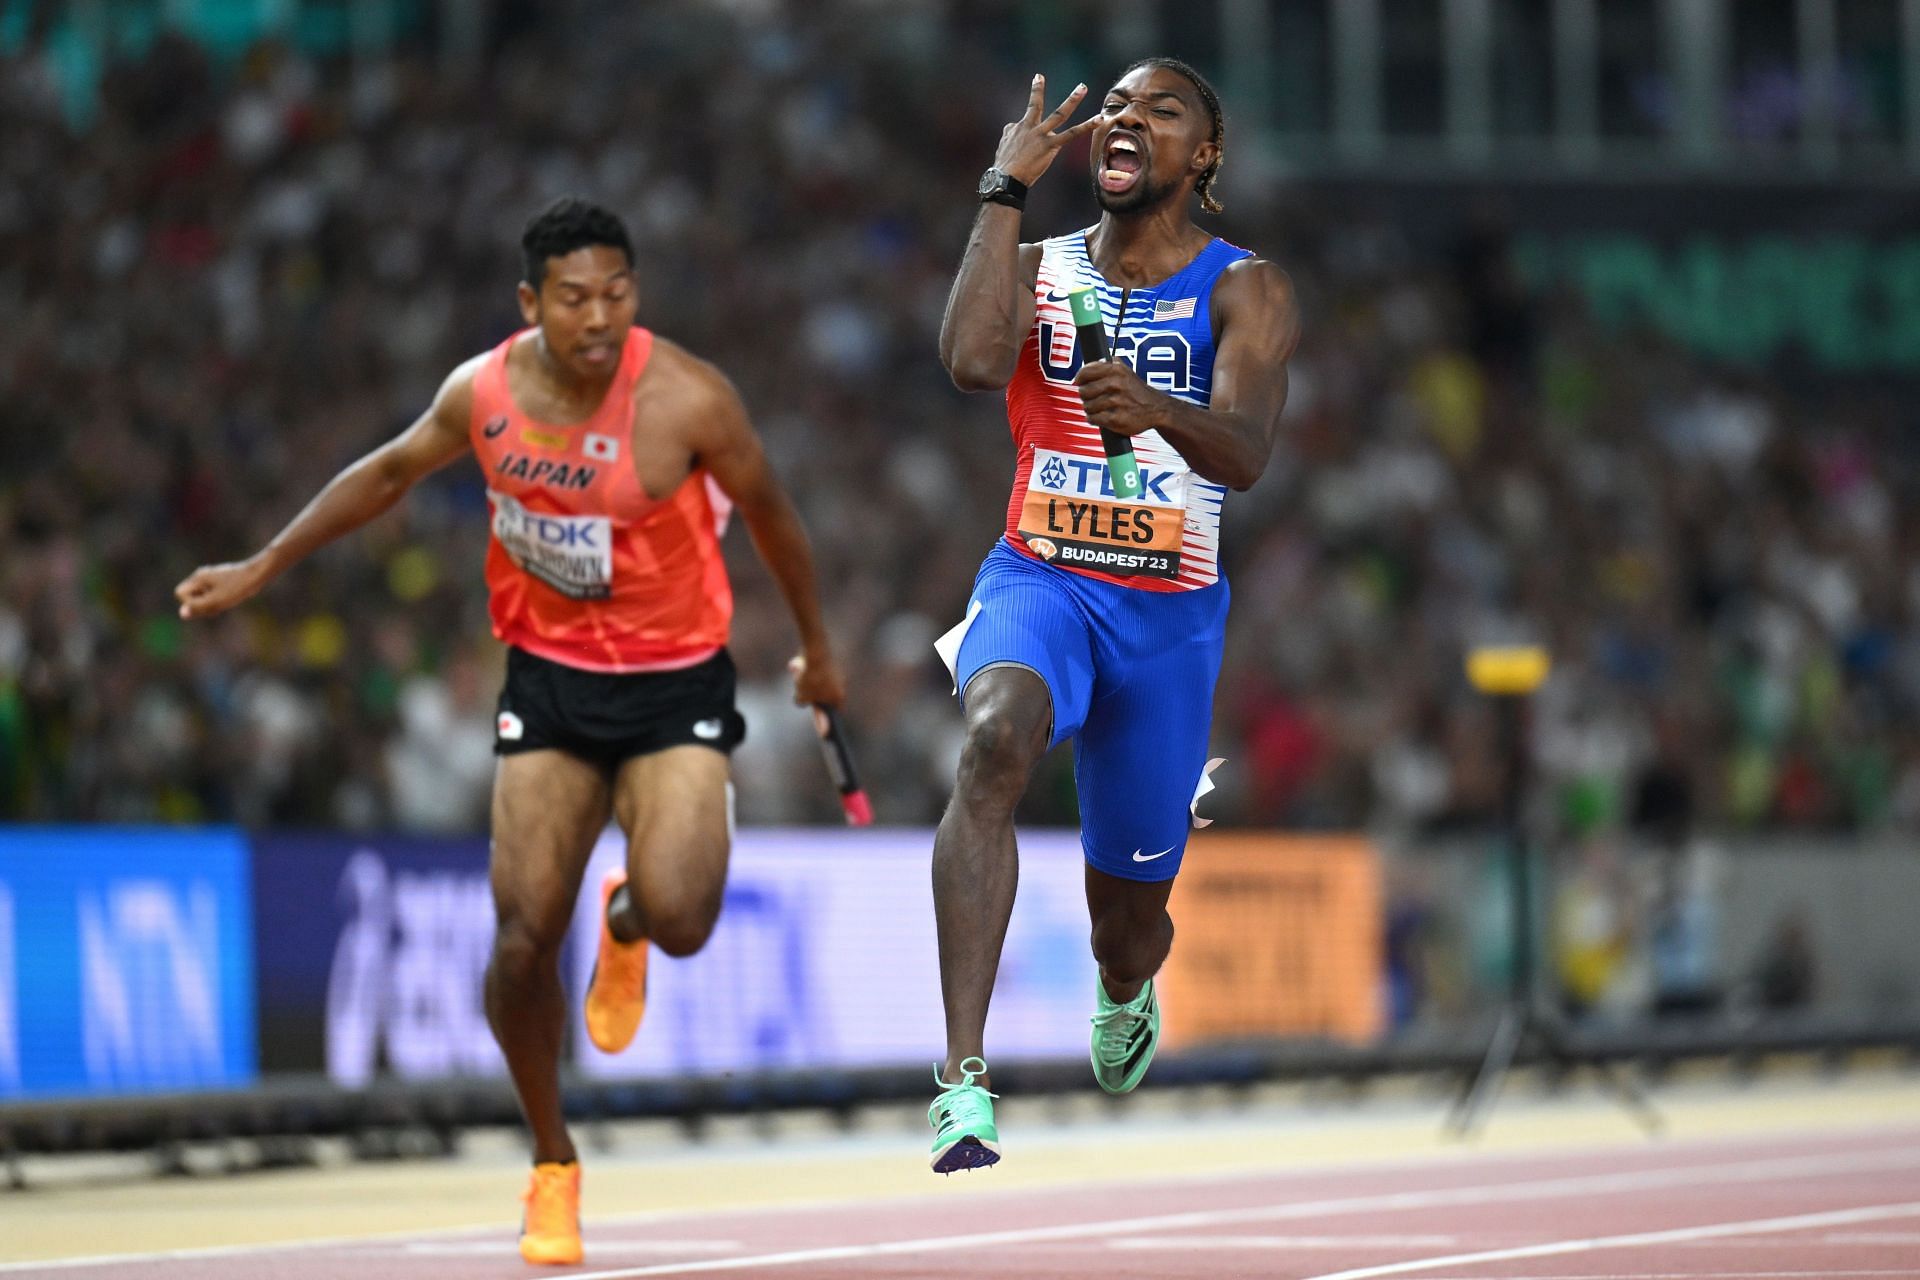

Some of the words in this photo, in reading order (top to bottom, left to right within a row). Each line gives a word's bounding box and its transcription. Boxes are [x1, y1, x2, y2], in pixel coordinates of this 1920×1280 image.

[1083, 293, 1097, 311] 8
[496, 454, 597, 488] JAPAN
[1123, 471, 1138, 488] 8
[1048, 498, 1154, 544] LYLES
[1062, 546, 1147, 568] BUDAPEST
[1149, 558, 1168, 570] 23
